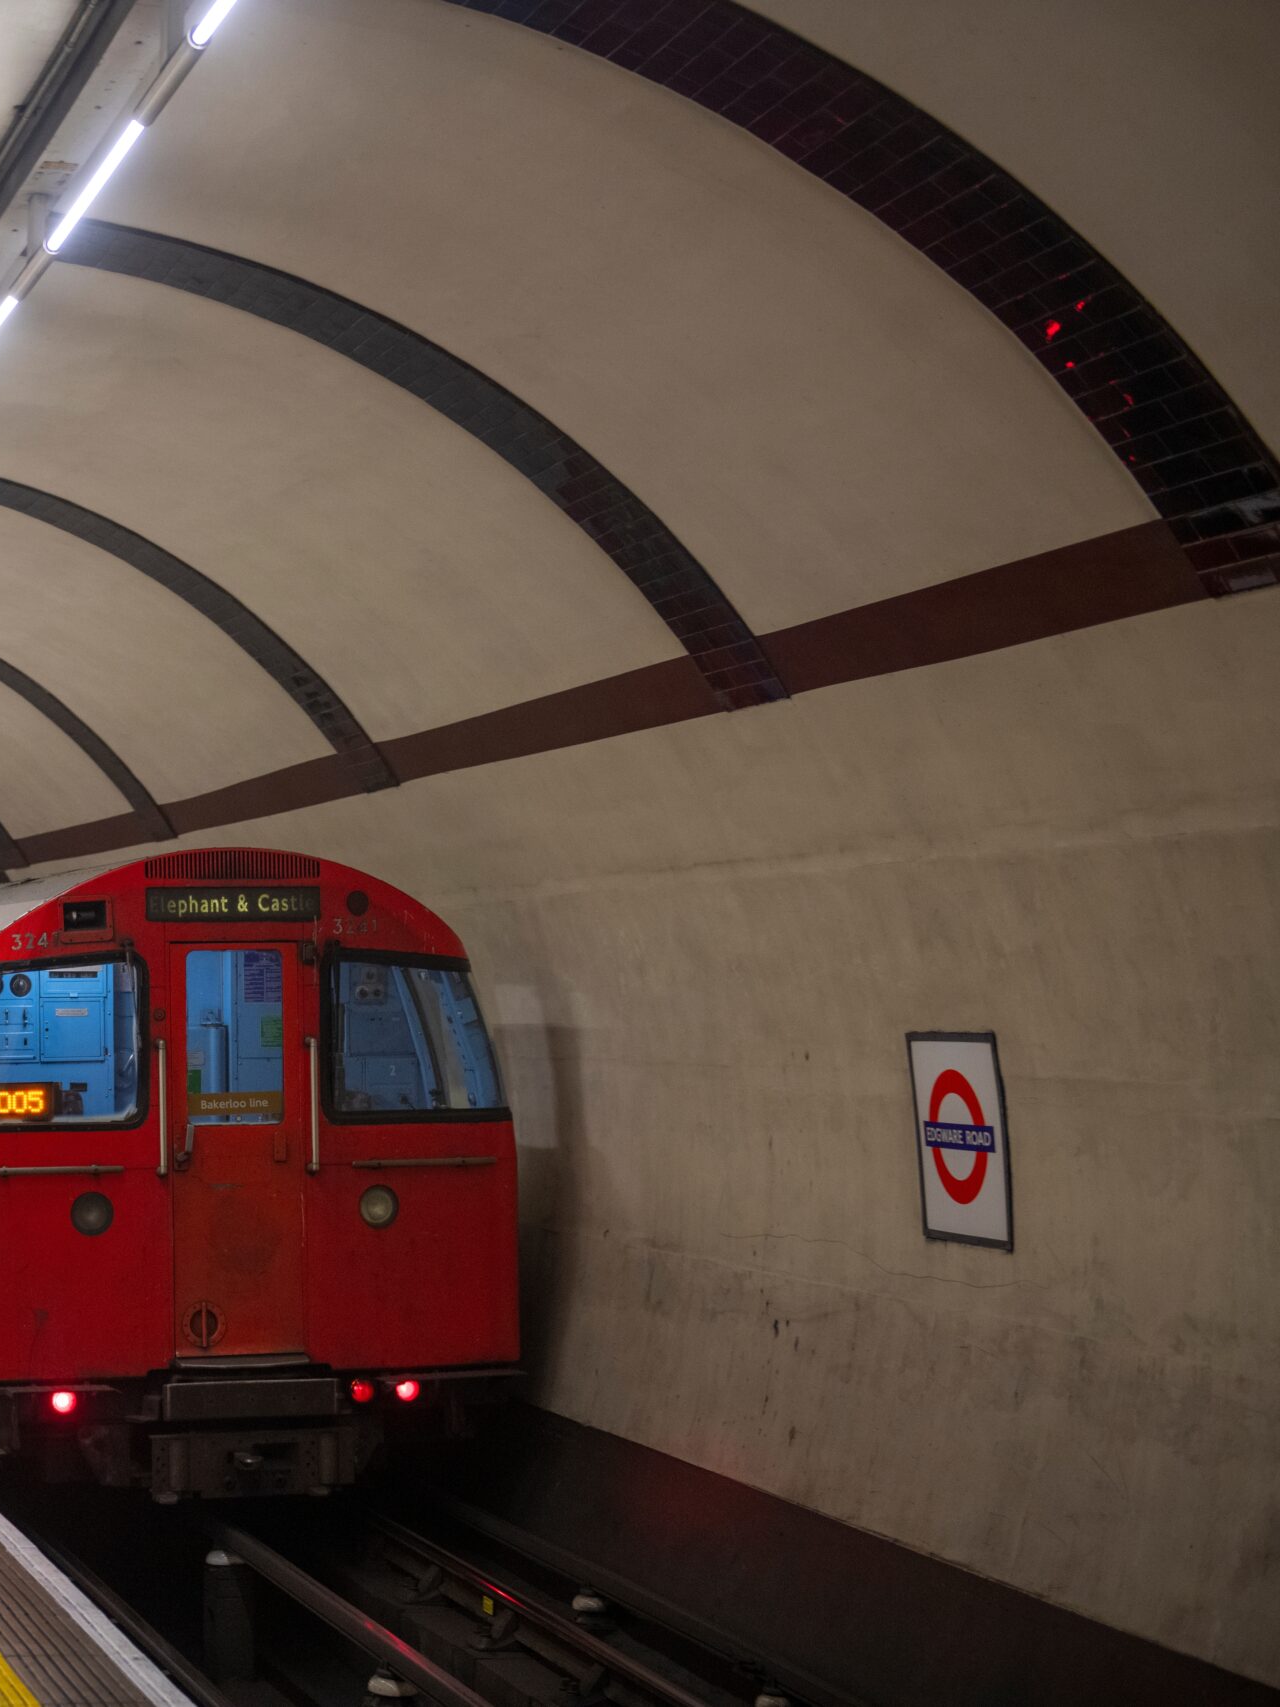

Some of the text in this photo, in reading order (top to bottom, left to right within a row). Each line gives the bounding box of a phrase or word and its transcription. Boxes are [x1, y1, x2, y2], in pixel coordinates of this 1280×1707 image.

[237, 894, 249, 912] &
[389, 1065, 396, 1076] 2
[200, 1097, 269, 1110] Bakerloo line
[926, 1126, 992, 1147] EDGWARE ROAD
